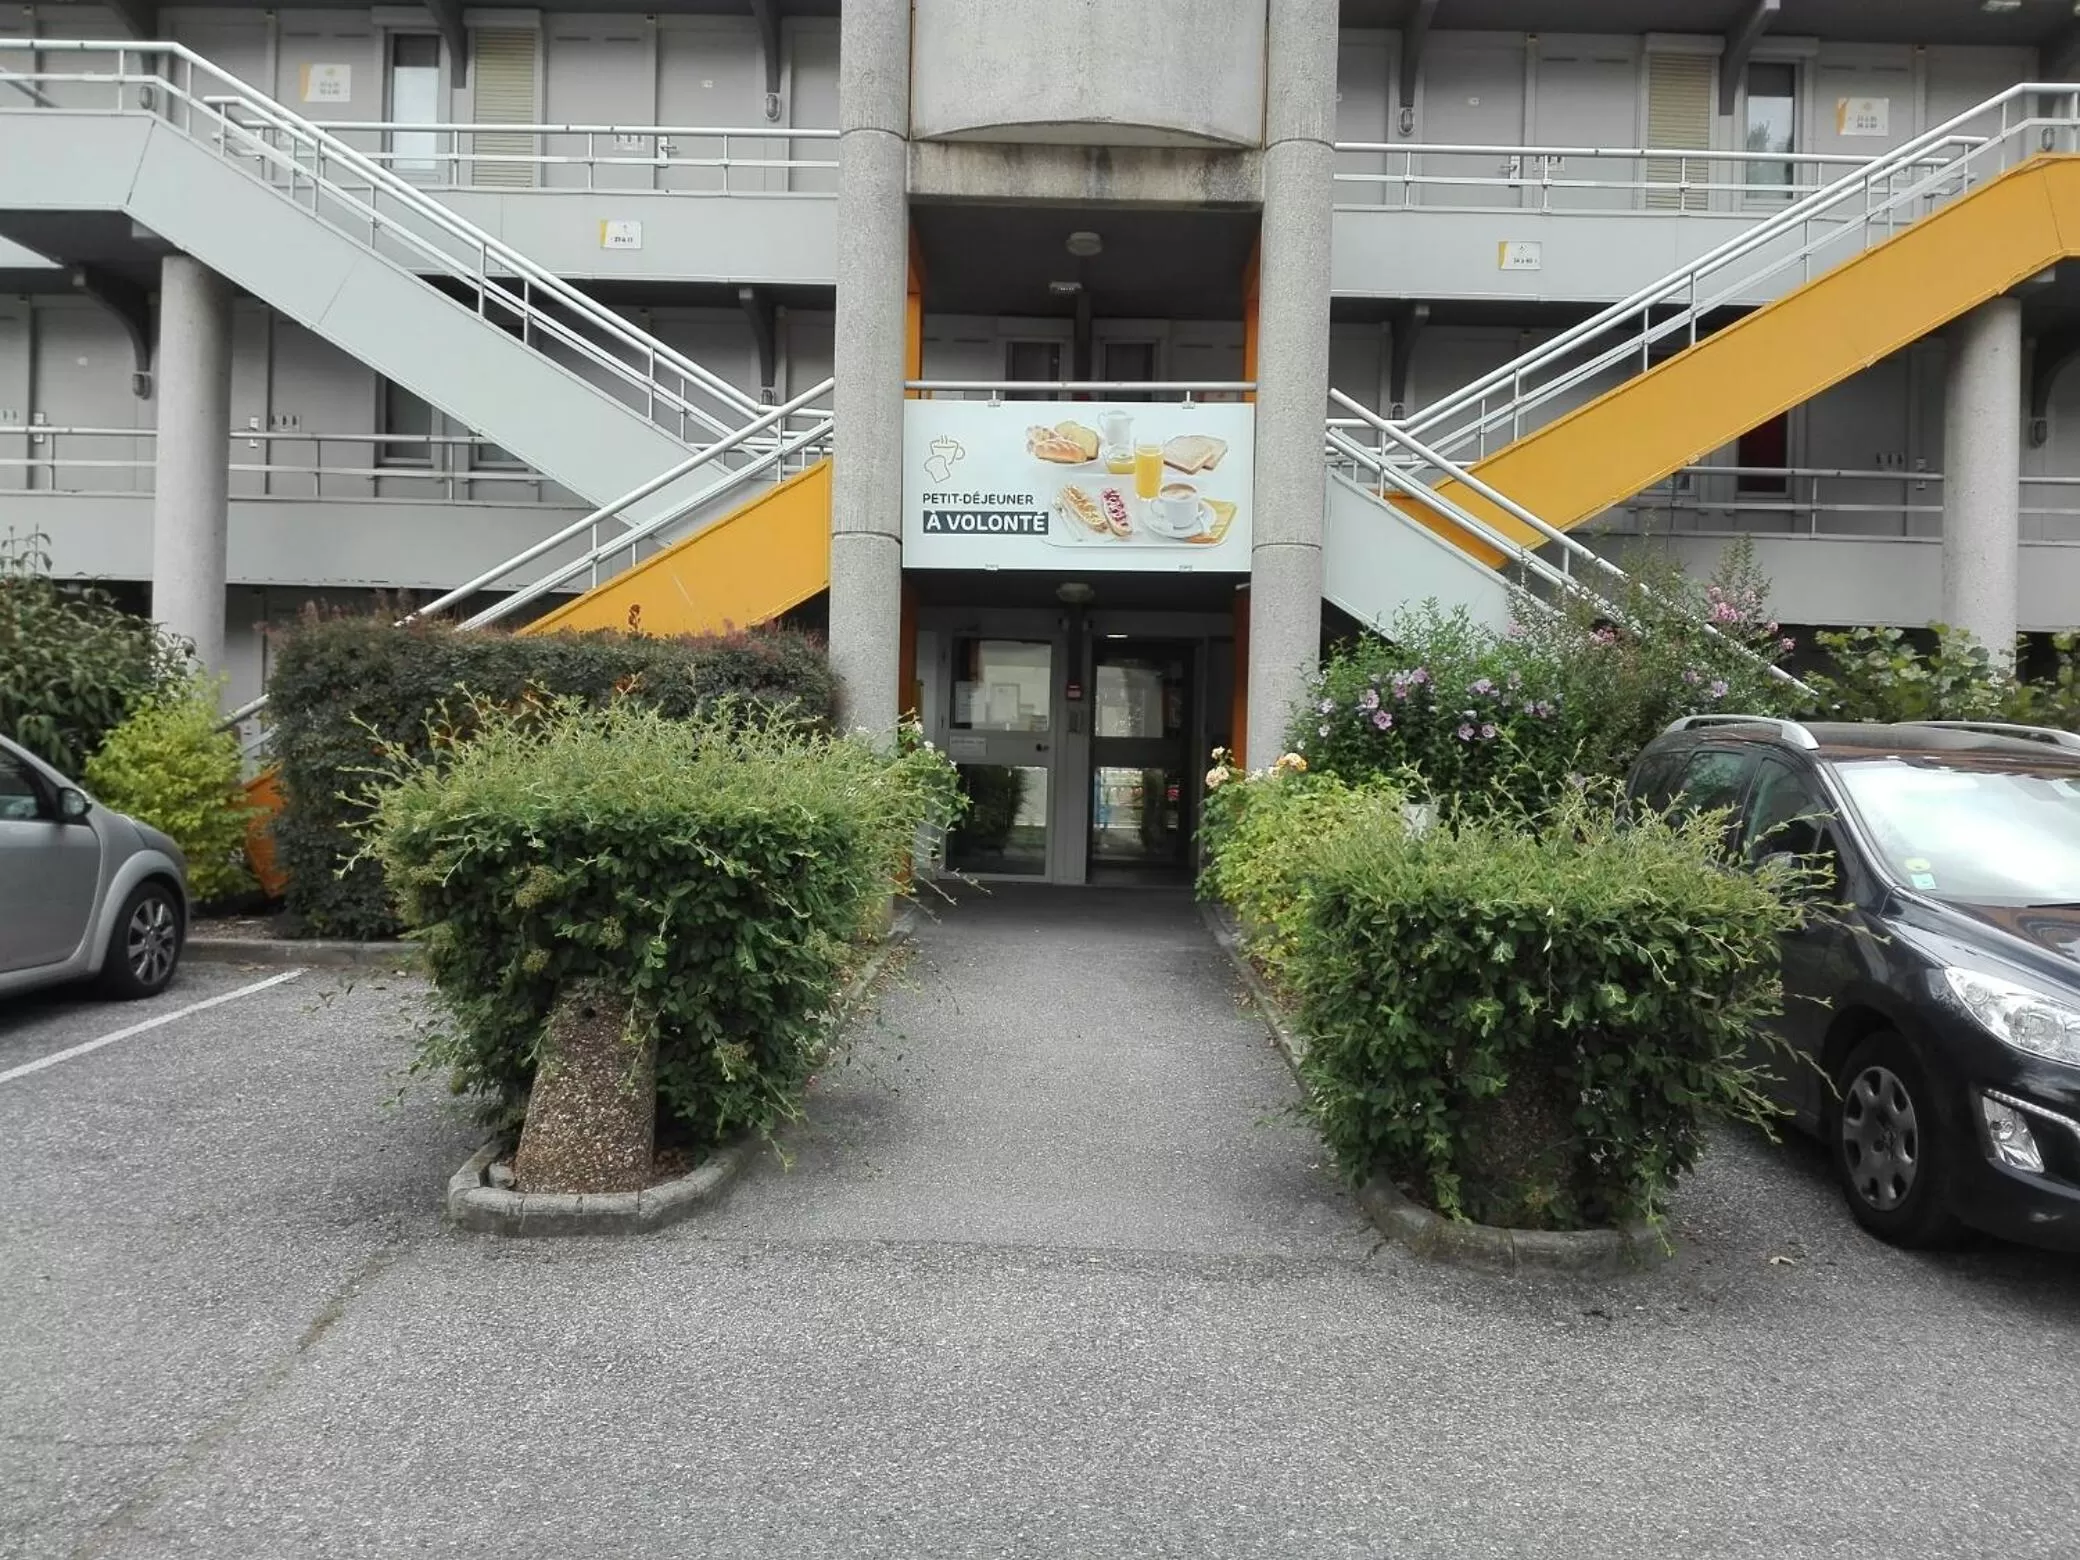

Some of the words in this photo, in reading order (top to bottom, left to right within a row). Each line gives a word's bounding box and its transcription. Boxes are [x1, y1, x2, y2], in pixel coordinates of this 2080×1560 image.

[922, 491, 1034, 504] PETIT-DÉJEUNER
[926, 510, 941, 530] À
[946, 511, 1045, 531] VOLONTÉ
